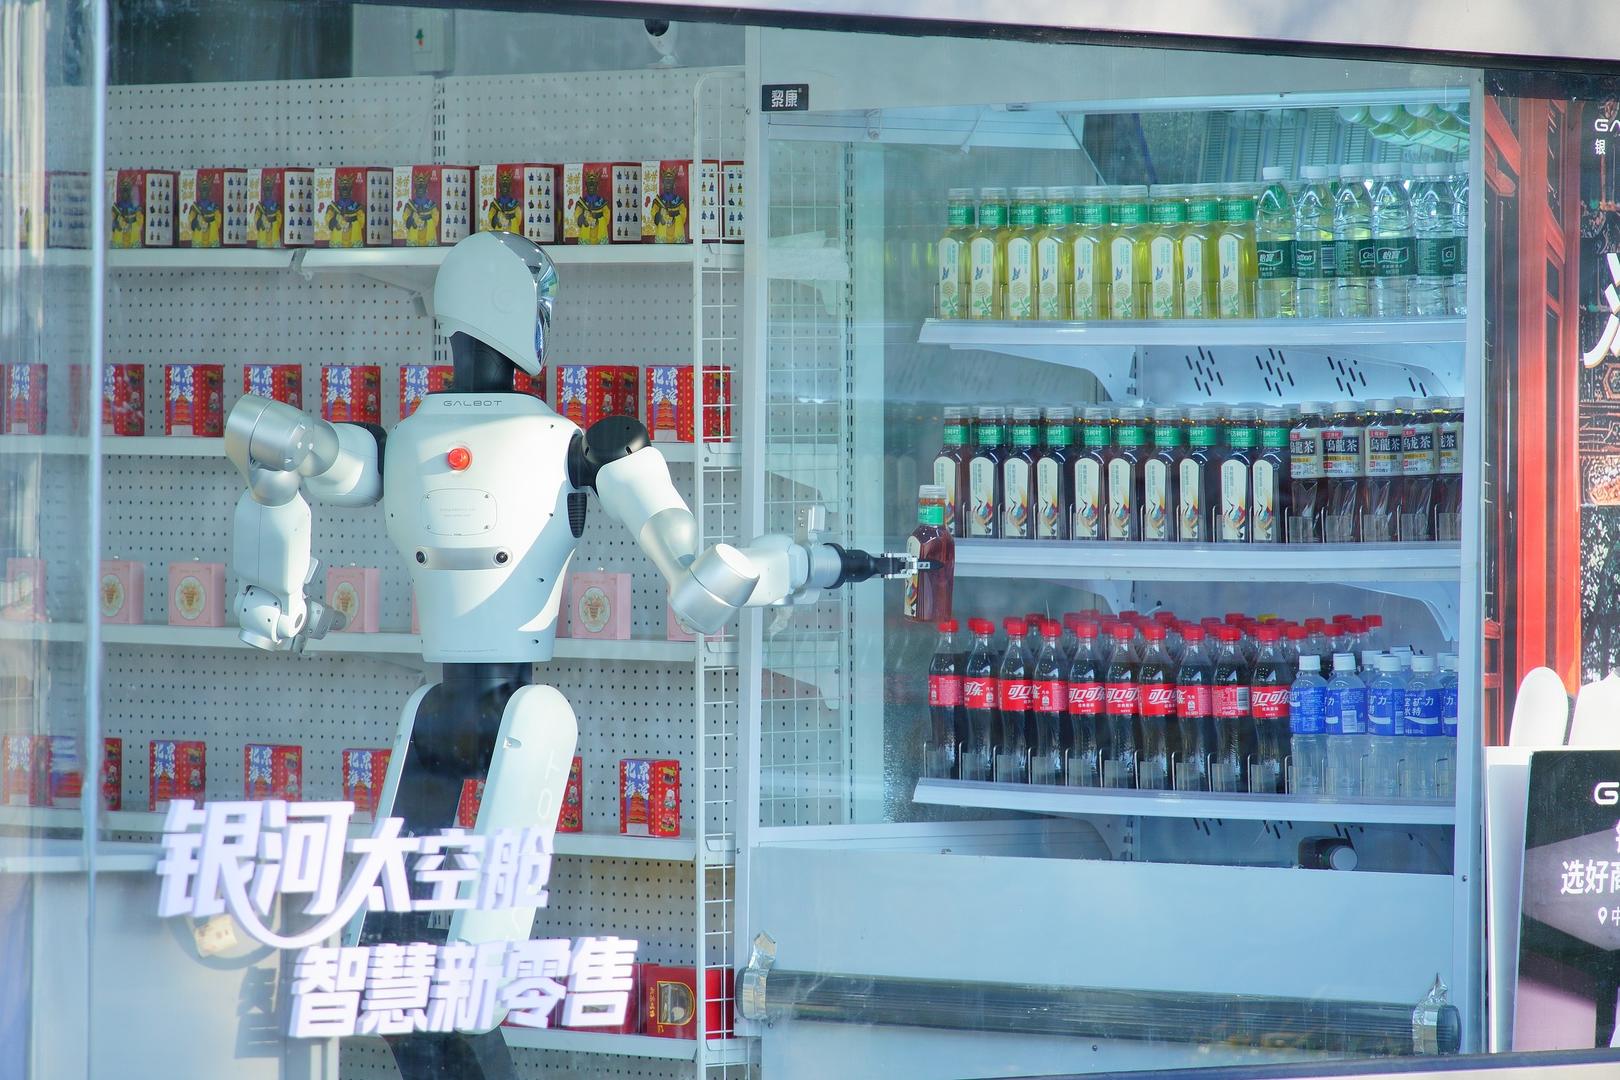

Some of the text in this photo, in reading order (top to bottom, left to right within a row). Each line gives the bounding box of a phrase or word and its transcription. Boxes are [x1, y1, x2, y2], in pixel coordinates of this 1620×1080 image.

[772, 89, 798, 108] 黎康
[561, 365, 587, 386] 北京
[651, 365, 678, 386] 北京
[624, 761, 650, 782] 北京
[156, 799, 555, 949] 银河太空舱
[287, 936, 640, 1039] 智慧新零售
